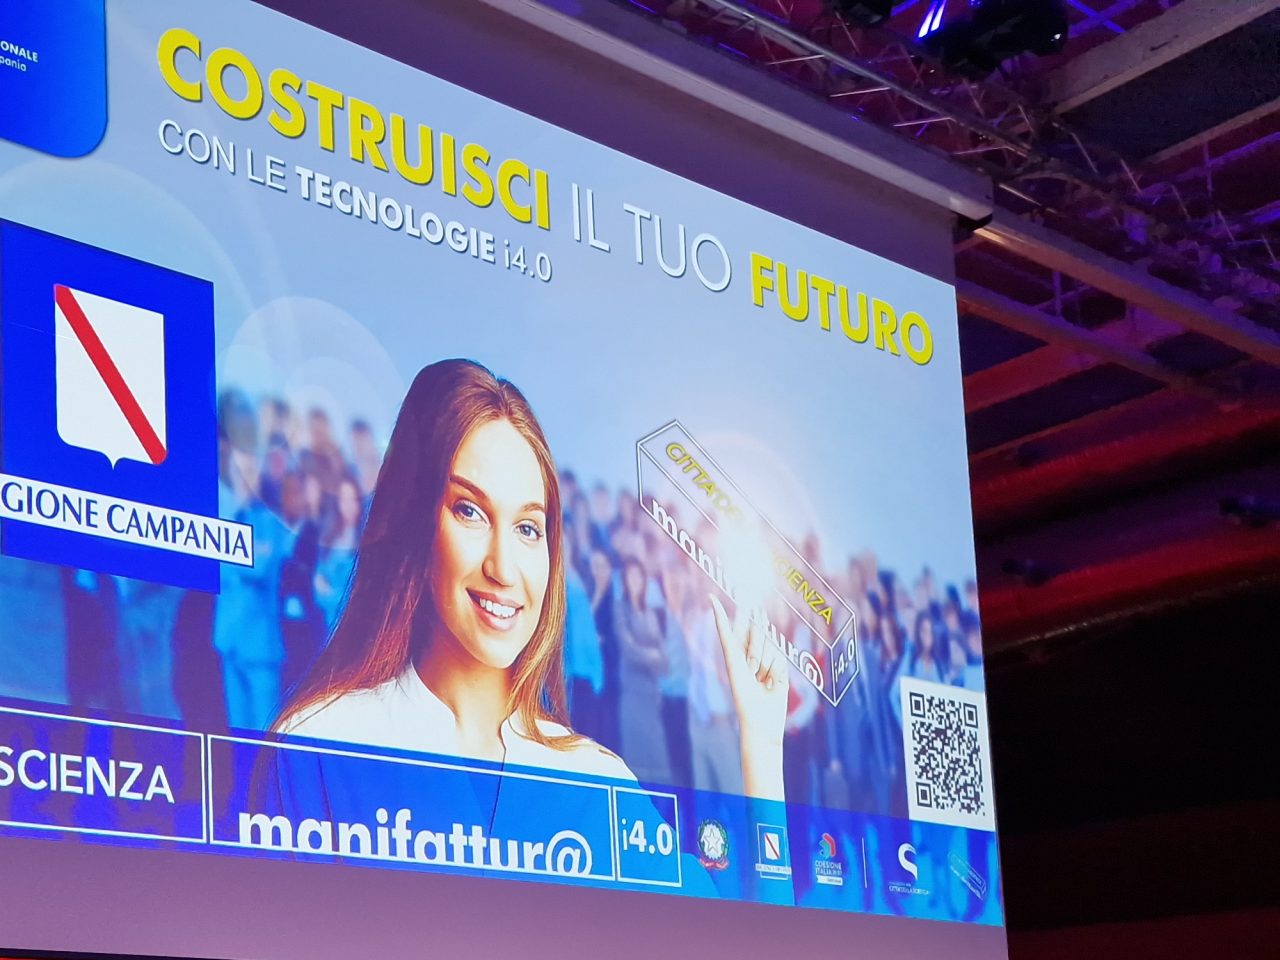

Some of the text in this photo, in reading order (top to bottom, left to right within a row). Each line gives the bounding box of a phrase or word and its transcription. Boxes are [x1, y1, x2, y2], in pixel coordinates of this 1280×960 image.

[157, 27, 935, 366] COSTRUISCI IL TUO FUTURO
[158, 119, 553, 284] CON LE TECNOLOGIE i4.0
[106, 503, 250, 559] CAMPANIA
[834, 639, 856, 684] i4.0
[238, 807, 594, 877] manifattur@
[621, 818, 674, 856] i4.0
